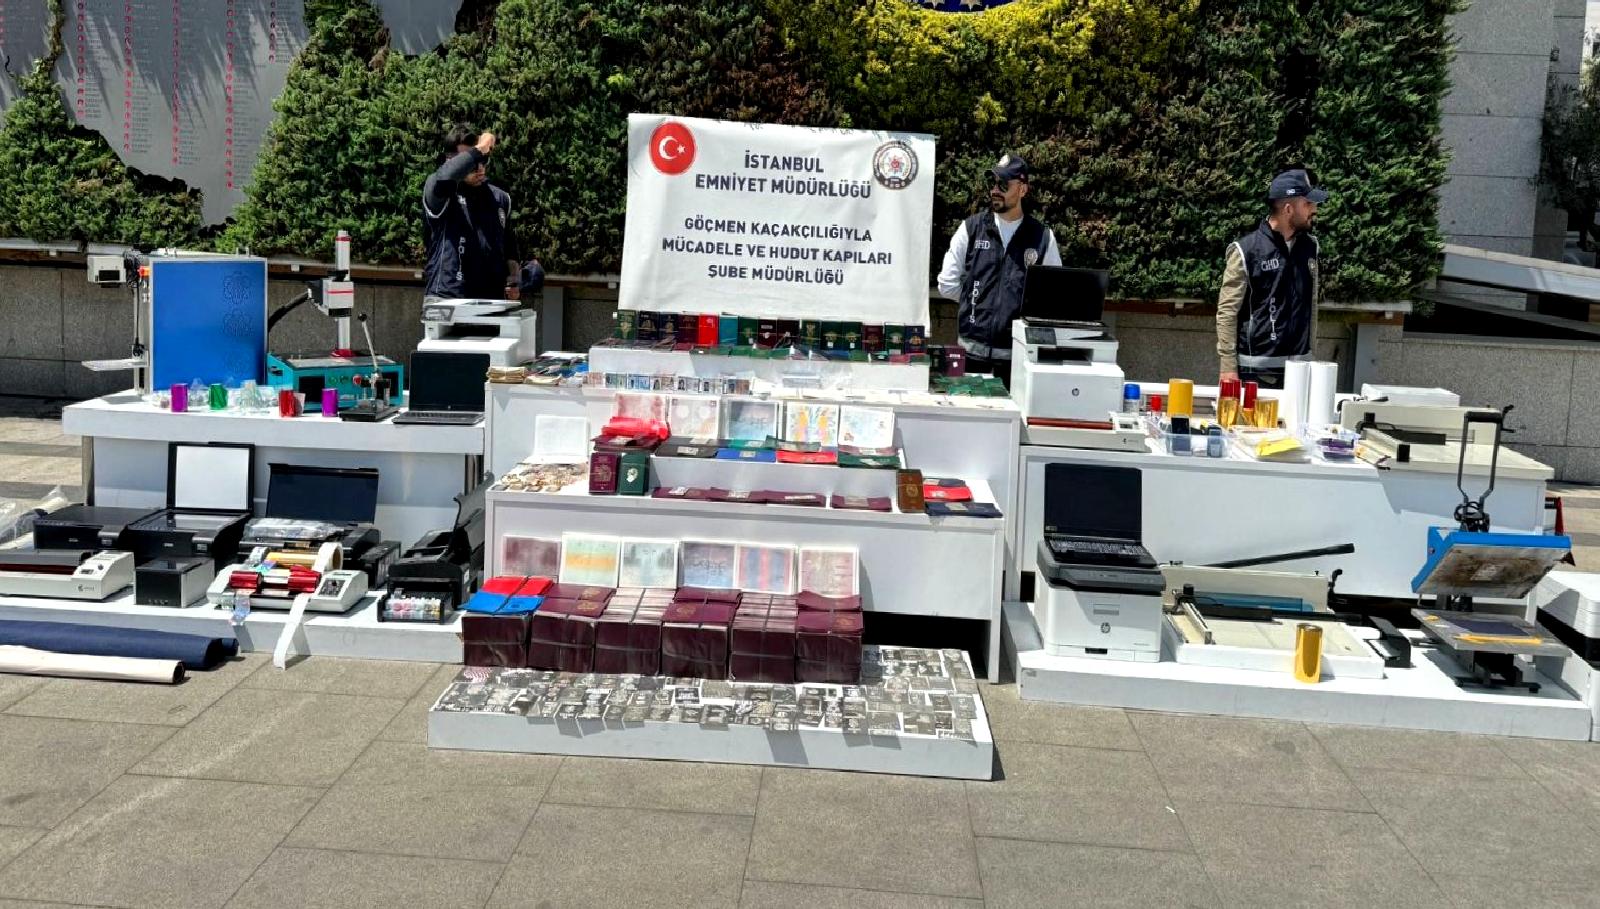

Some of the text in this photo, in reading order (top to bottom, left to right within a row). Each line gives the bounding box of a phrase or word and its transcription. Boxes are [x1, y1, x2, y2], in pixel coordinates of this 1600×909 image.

[744, 150, 824, 173] İSTANBUL
[695, 172, 871, 199] EMNİYET MÜDÜRLÜĞÜ
[684, 214, 872, 242] GÖÇMEN KAÇAKÇILIĞIYLA
[662, 236, 892, 265] MÜCADELE VE HUDUT KAPILARI
[708, 264, 844, 285] ŞUBE MÜDÜRLÜĞÜ
